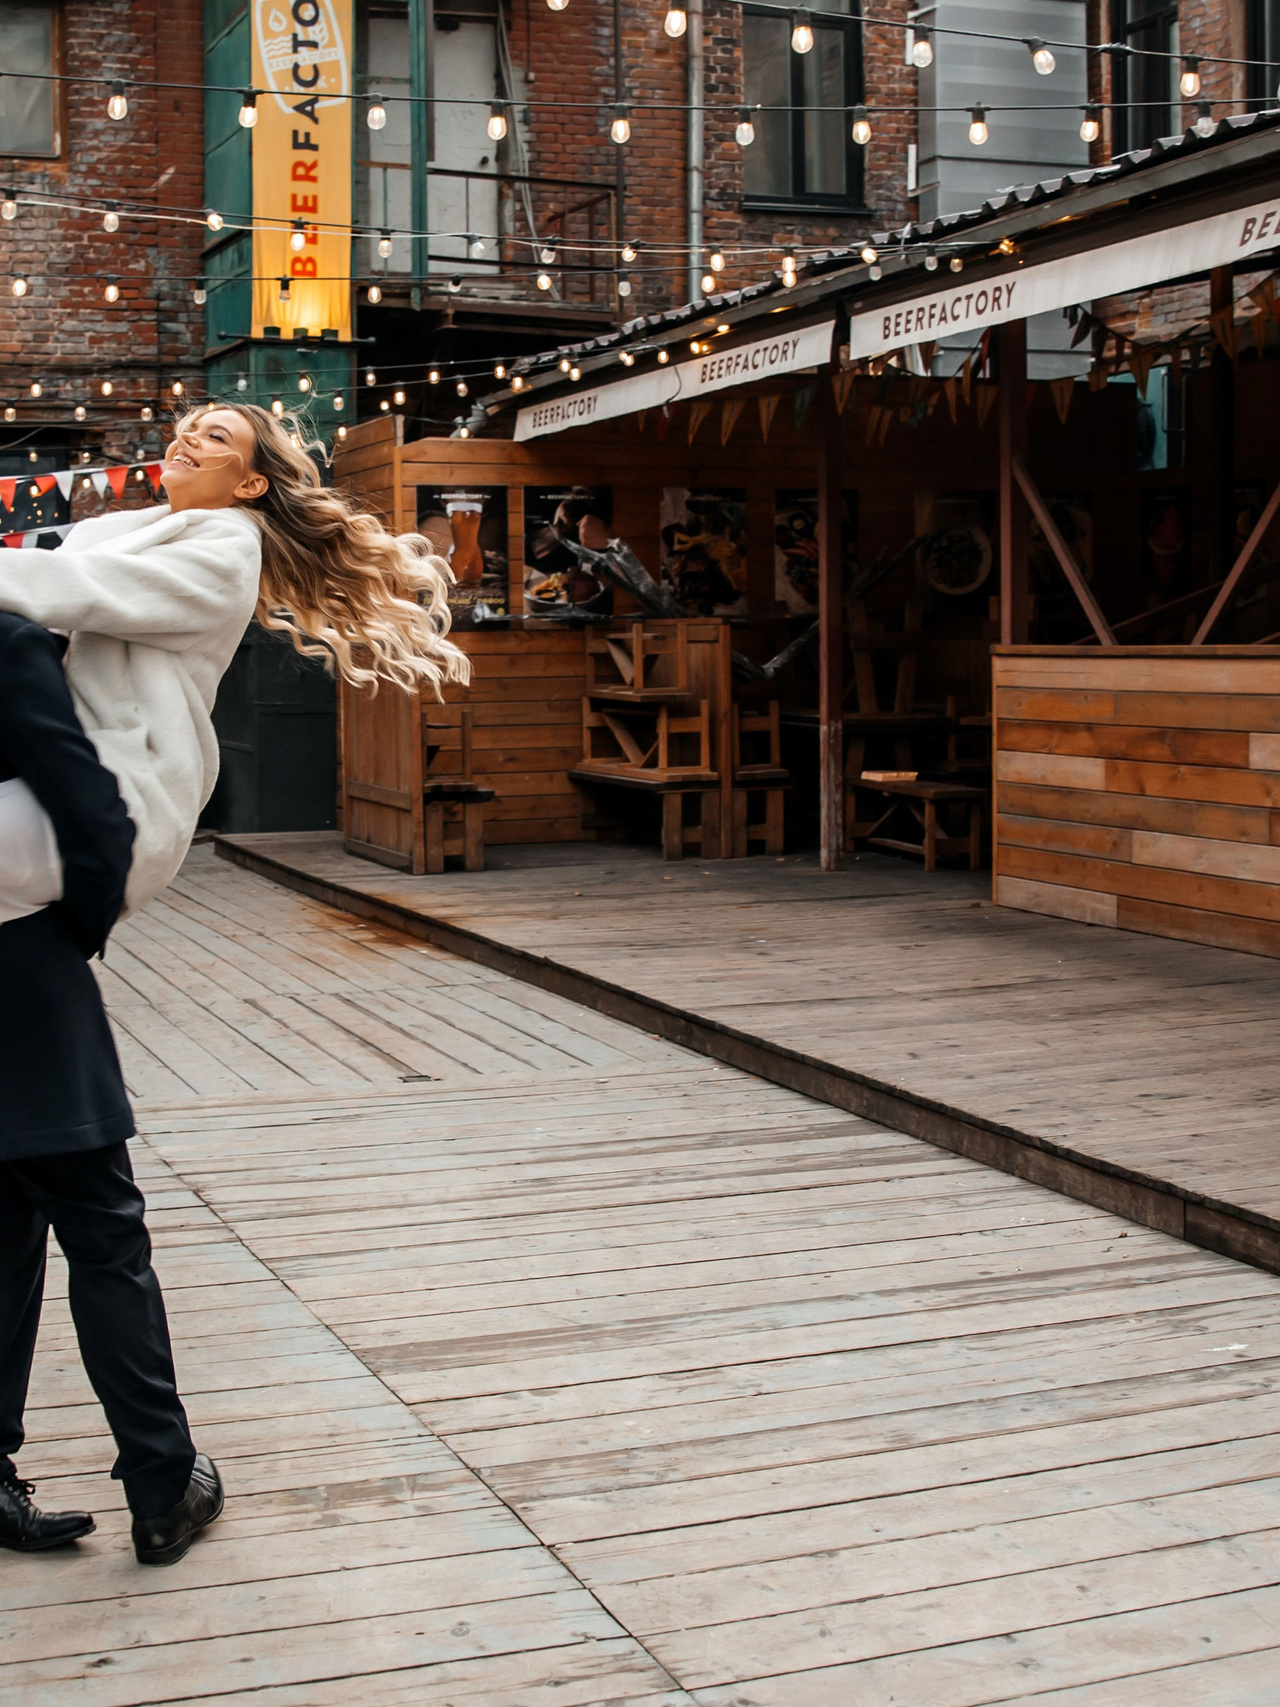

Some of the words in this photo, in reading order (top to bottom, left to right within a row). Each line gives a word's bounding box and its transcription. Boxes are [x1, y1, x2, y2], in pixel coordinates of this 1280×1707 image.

[882, 280, 1017, 341] BEERFACTORY
[700, 338, 801, 384] BEERFACTORY
[532, 395, 599, 429] BEERFACTORY
